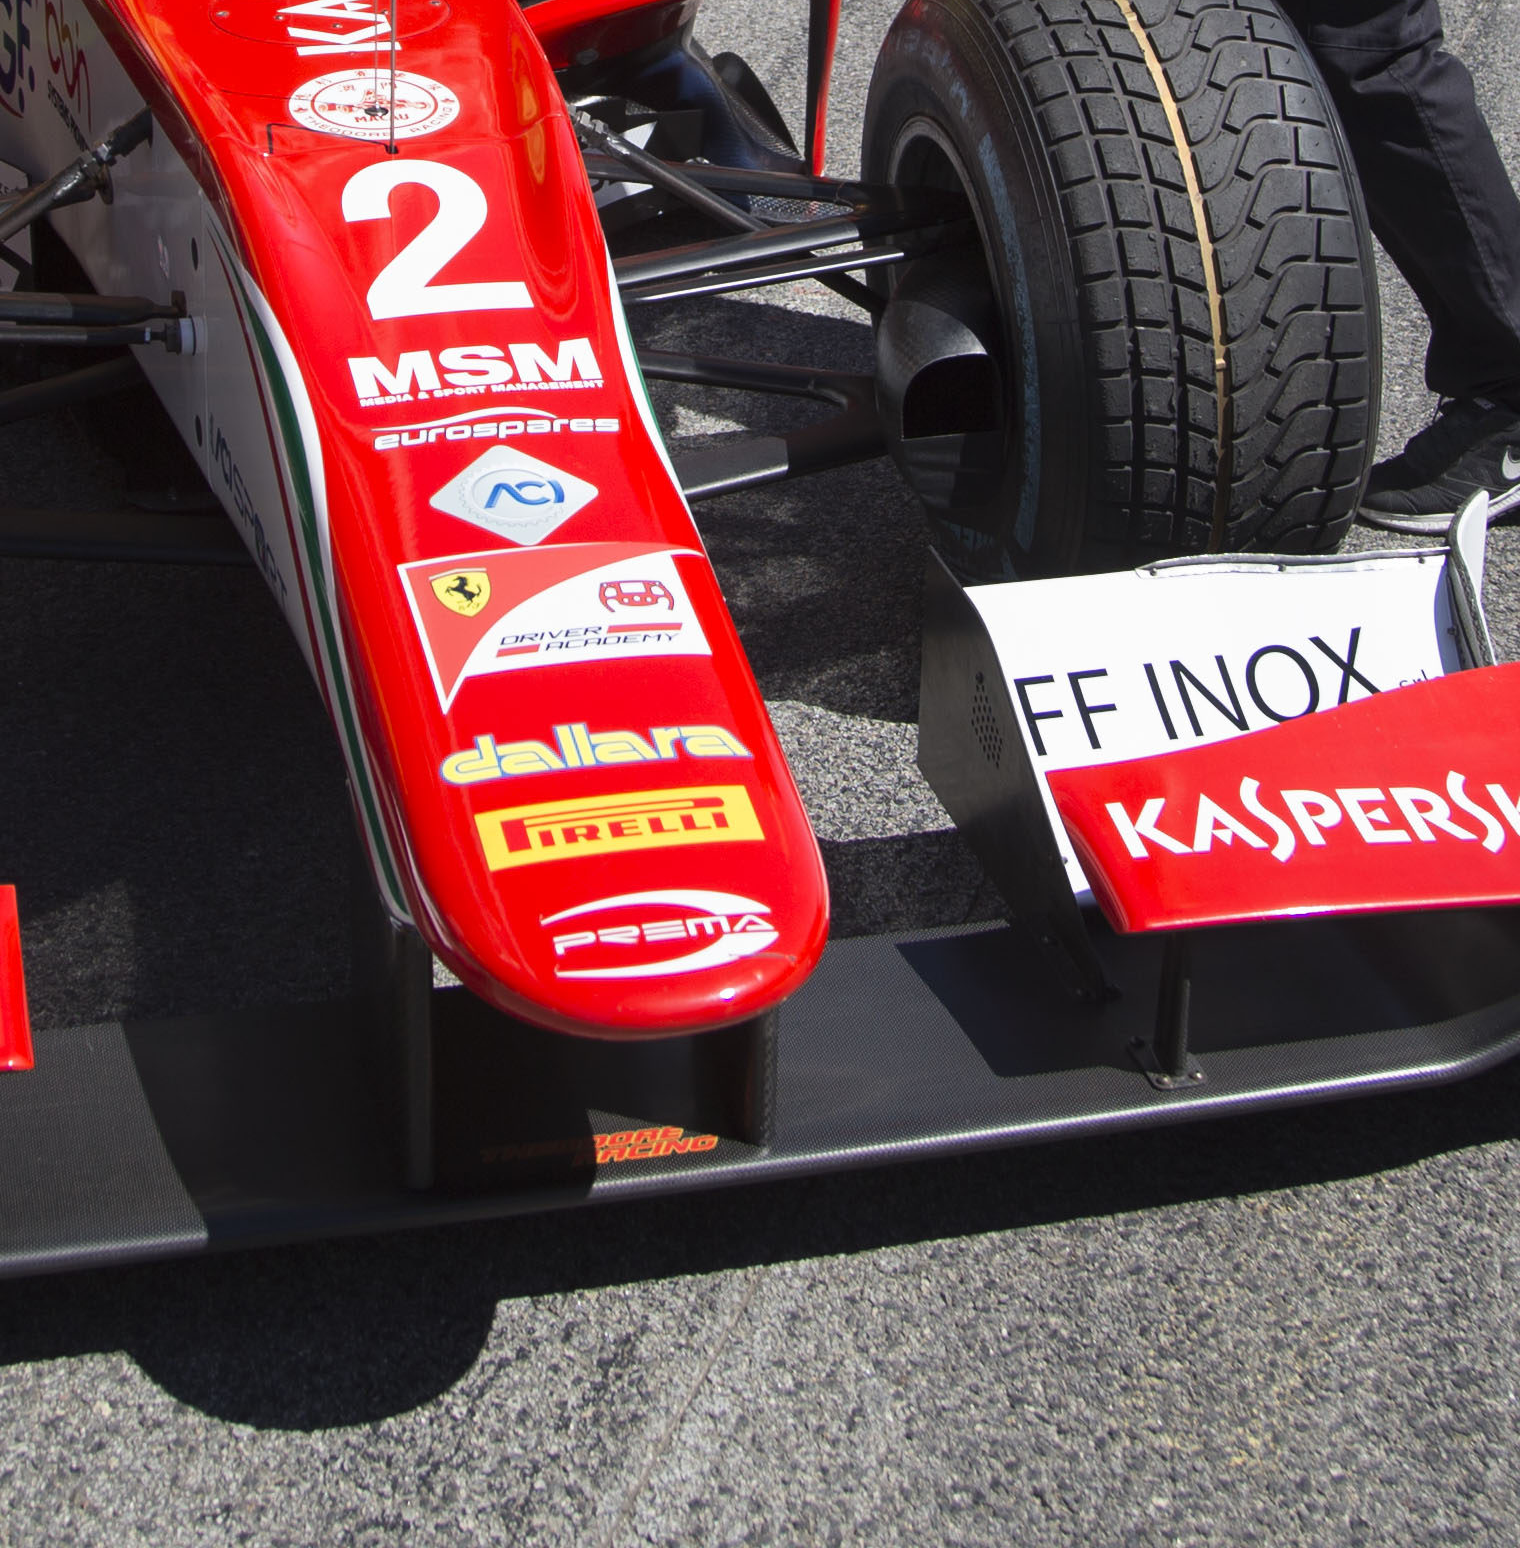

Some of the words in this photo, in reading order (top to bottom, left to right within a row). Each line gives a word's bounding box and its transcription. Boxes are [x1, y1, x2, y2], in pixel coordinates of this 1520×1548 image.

[341, 159, 534, 321] 2
[347, 337, 602, 398] MSM
[359, 395, 413, 409] MEDIA
[417, 391, 429, 402] &
[432, 386, 487, 401] SPORT
[491, 378, 605, 394] MANAGEMENT
[374, 416, 620, 450] eurospares
[500, 625, 603, 647] DRIVER
[545, 632, 681, 653] ACADEMY
[1013, 668, 1117, 756] FF
[1143, 626, 1383, 742] INOX
[441, 723, 755, 787] dallara
[501, 796, 730, 854] PIRELLI
[553, 911, 779, 956] PREMA
